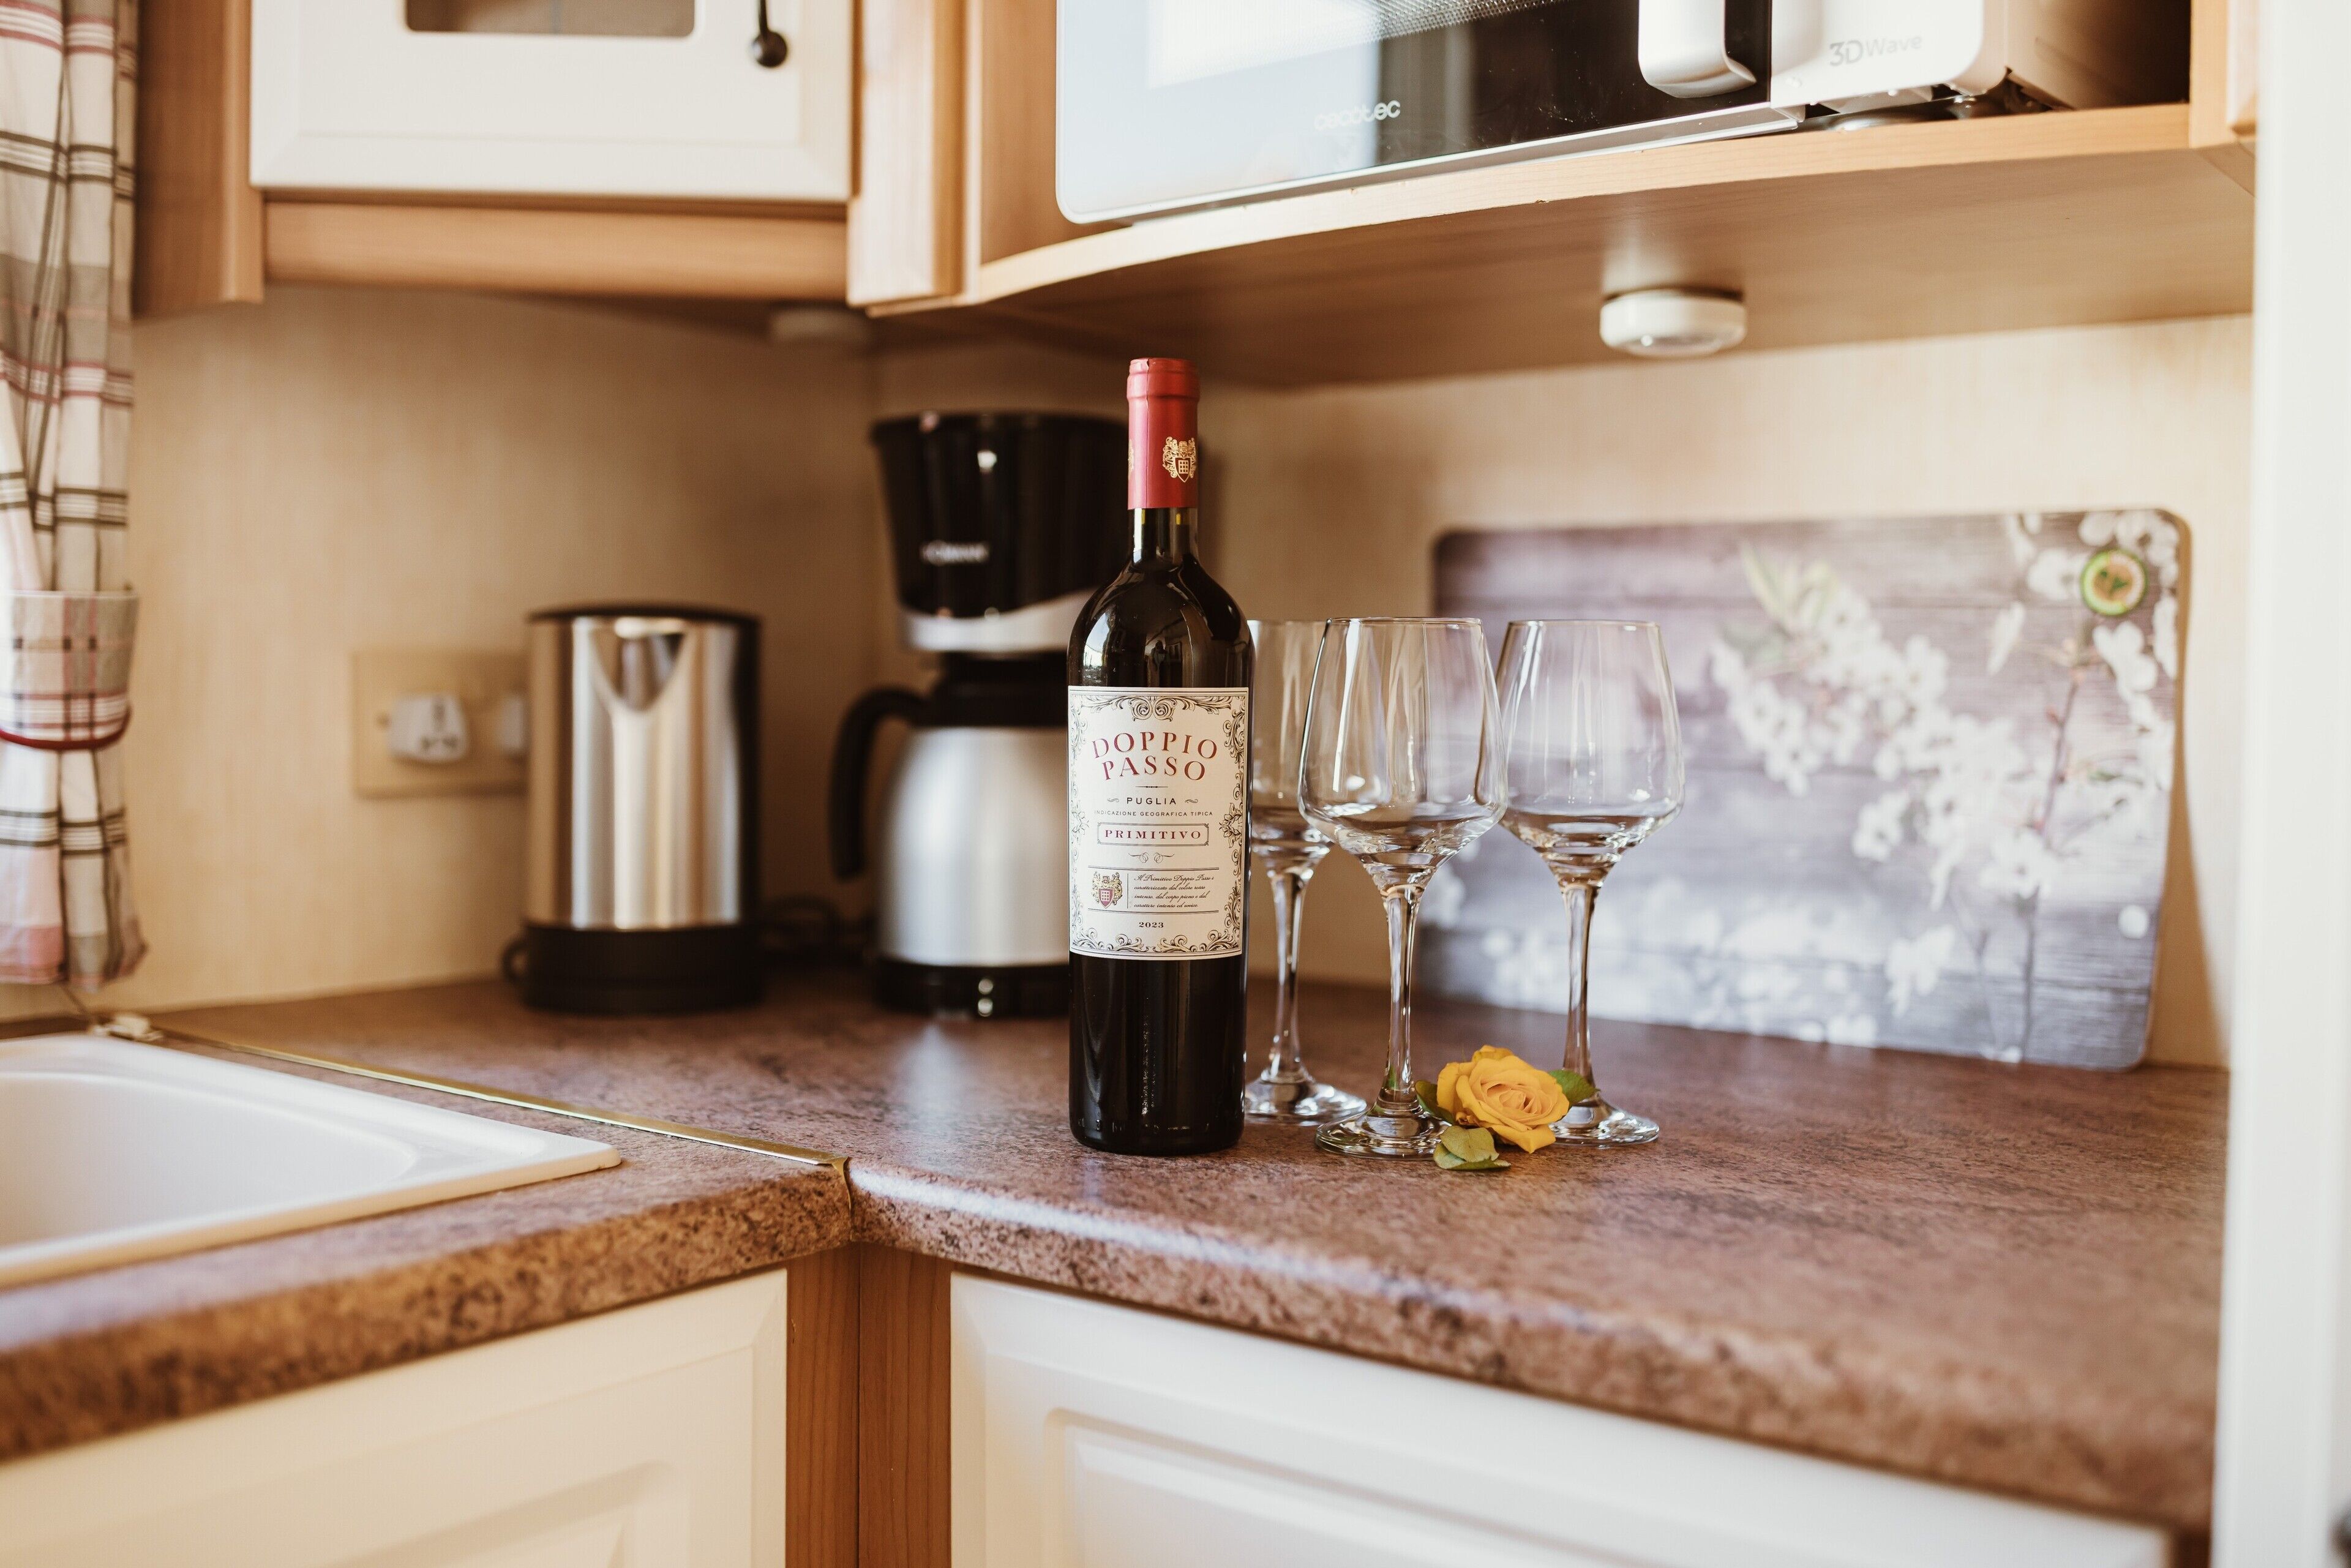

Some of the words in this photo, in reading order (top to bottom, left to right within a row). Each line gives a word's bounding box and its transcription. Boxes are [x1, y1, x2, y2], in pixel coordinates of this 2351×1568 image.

[1092, 731, 1217, 759] DOPPIO
[1101, 755, 1205, 781] PASSO
[1104, 830, 1201, 839] PRIMITIVO
[1173, 874, 1194, 885] Doppio
[1168, 882, 1182, 890] dal
[1155, 891, 1169, 899] dal
[1177, 895, 1194, 903] pieno
